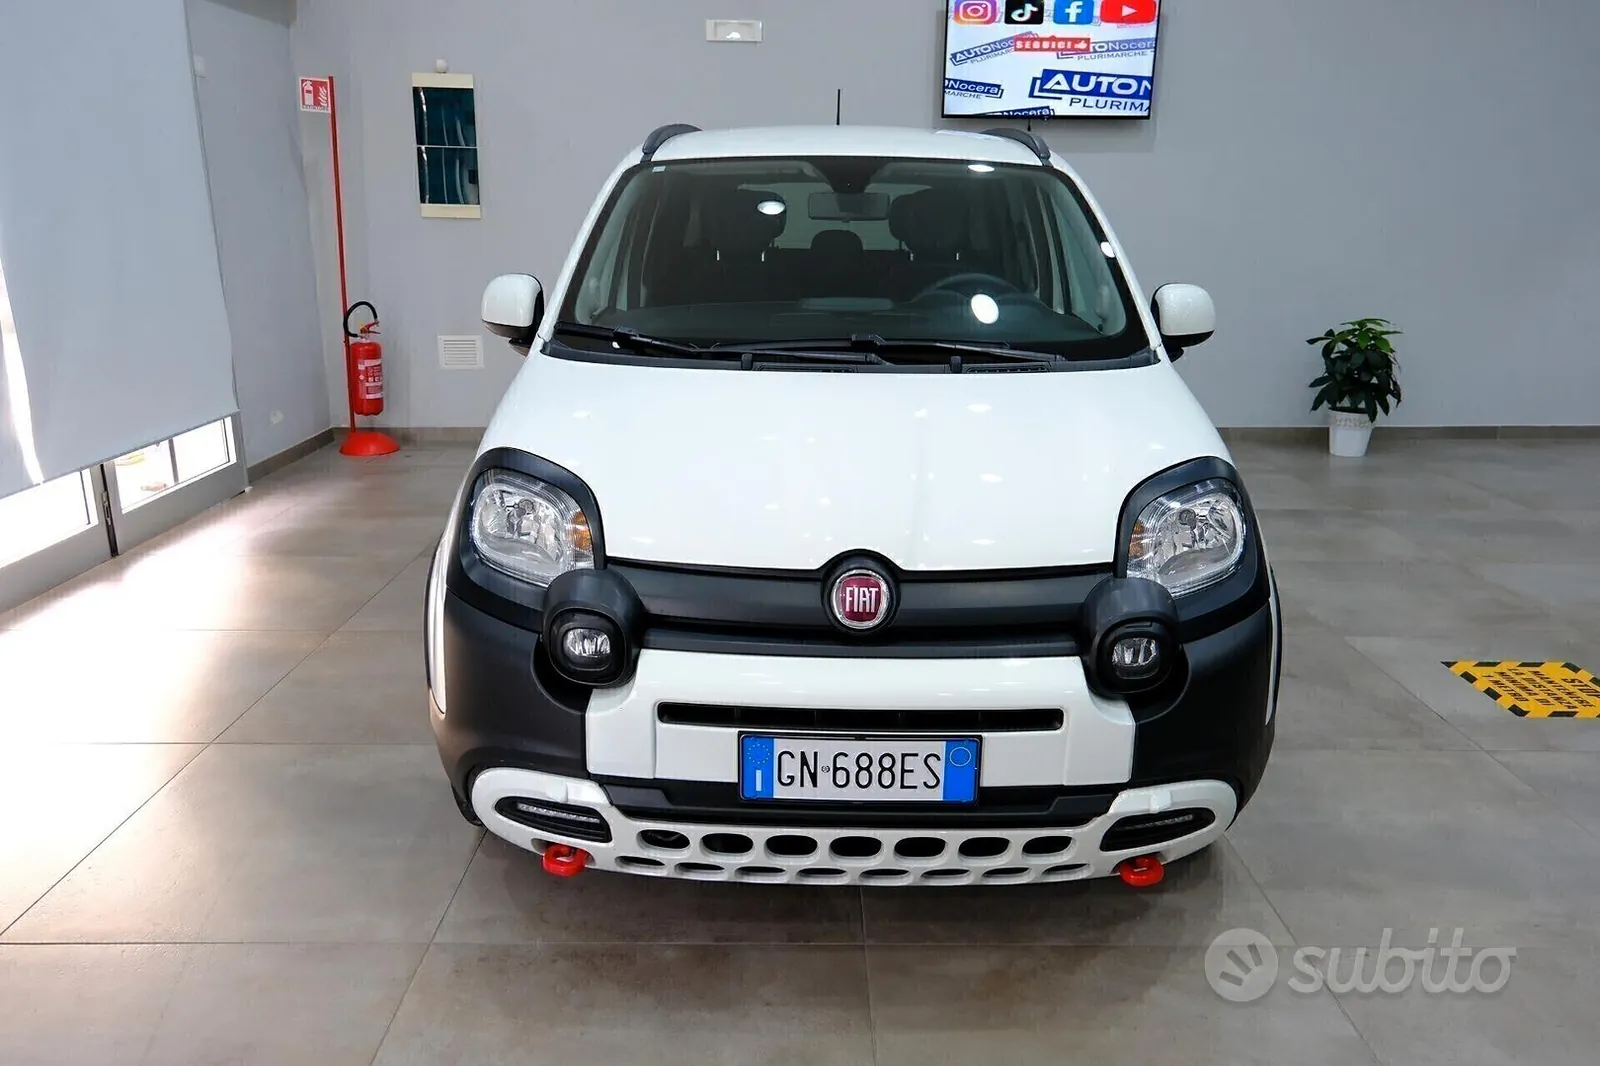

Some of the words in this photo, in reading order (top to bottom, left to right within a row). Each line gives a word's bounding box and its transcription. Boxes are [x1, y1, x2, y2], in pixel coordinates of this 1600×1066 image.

[956, 38, 1016, 61] AUTONoc
[945, 80, 998, 93] Nocera
[845, 586, 879, 613] FIAT
